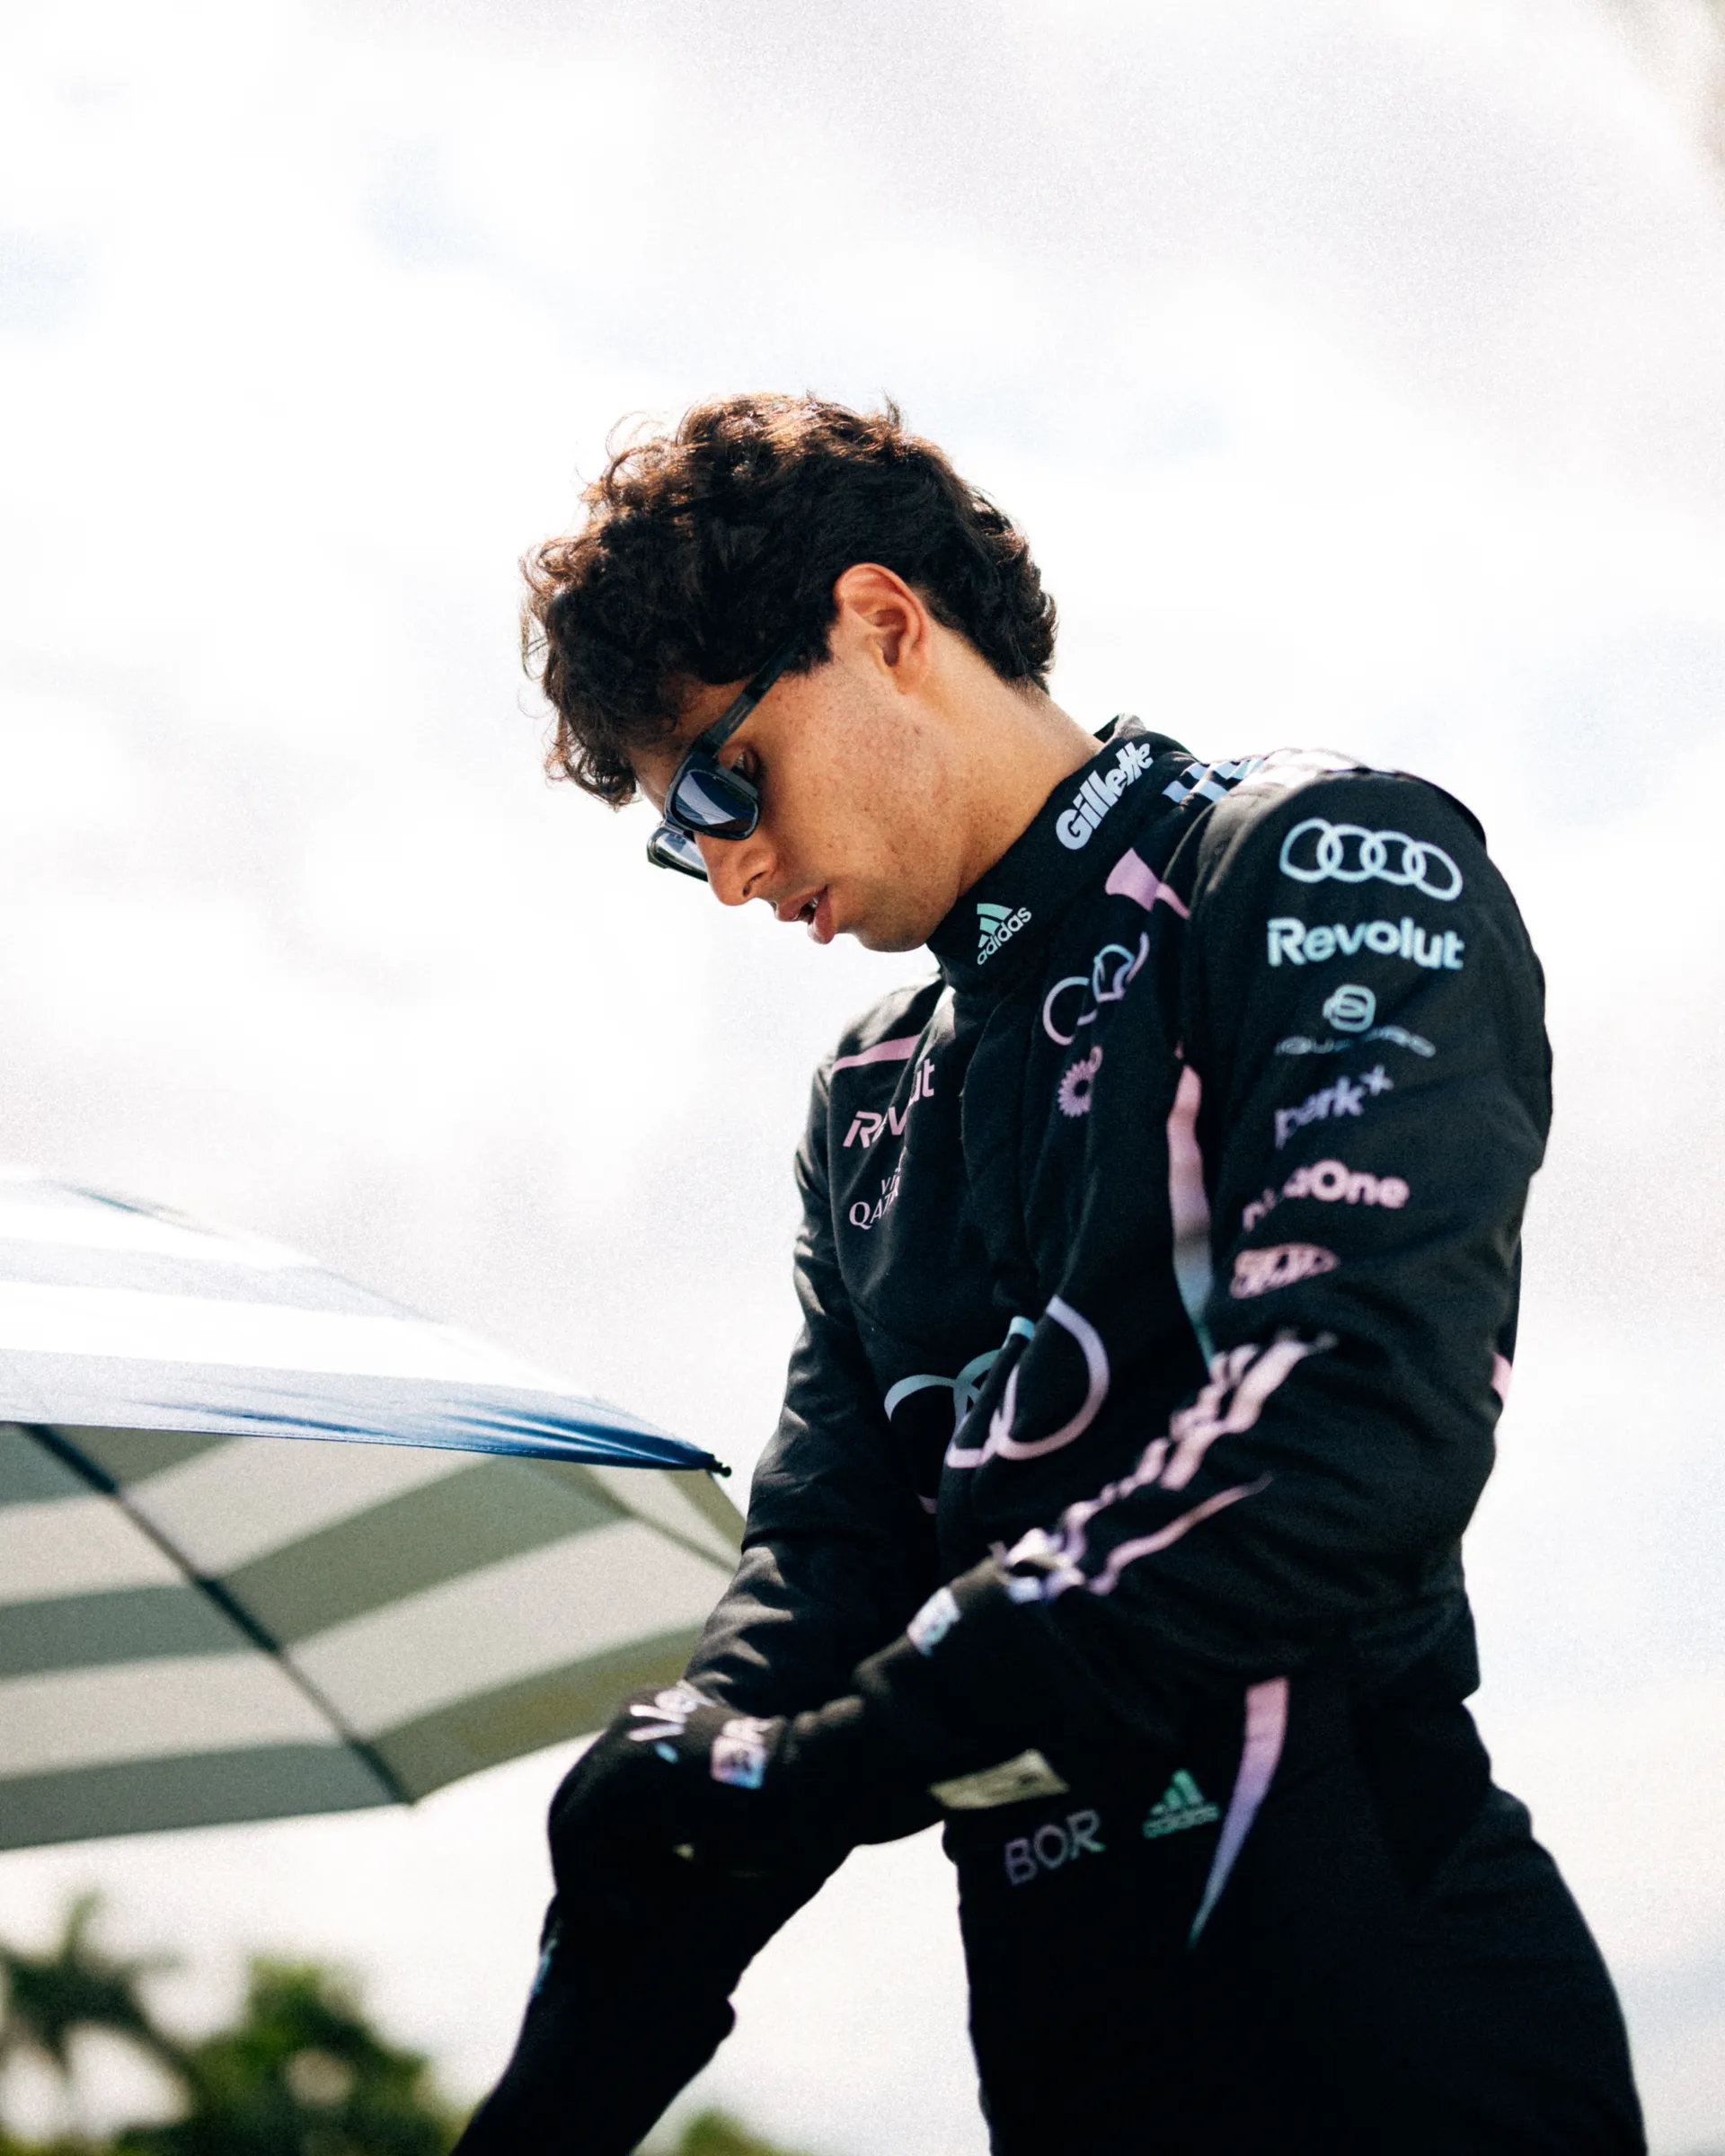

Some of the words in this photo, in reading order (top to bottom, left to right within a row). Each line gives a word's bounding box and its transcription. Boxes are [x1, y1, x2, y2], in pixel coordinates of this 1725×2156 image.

[1056, 741, 1154, 850] Gillette
[977, 907, 1031, 966] adidas
[1267, 917, 1464, 970] Revolut
[1004, 1809, 1105, 1885] BOR
